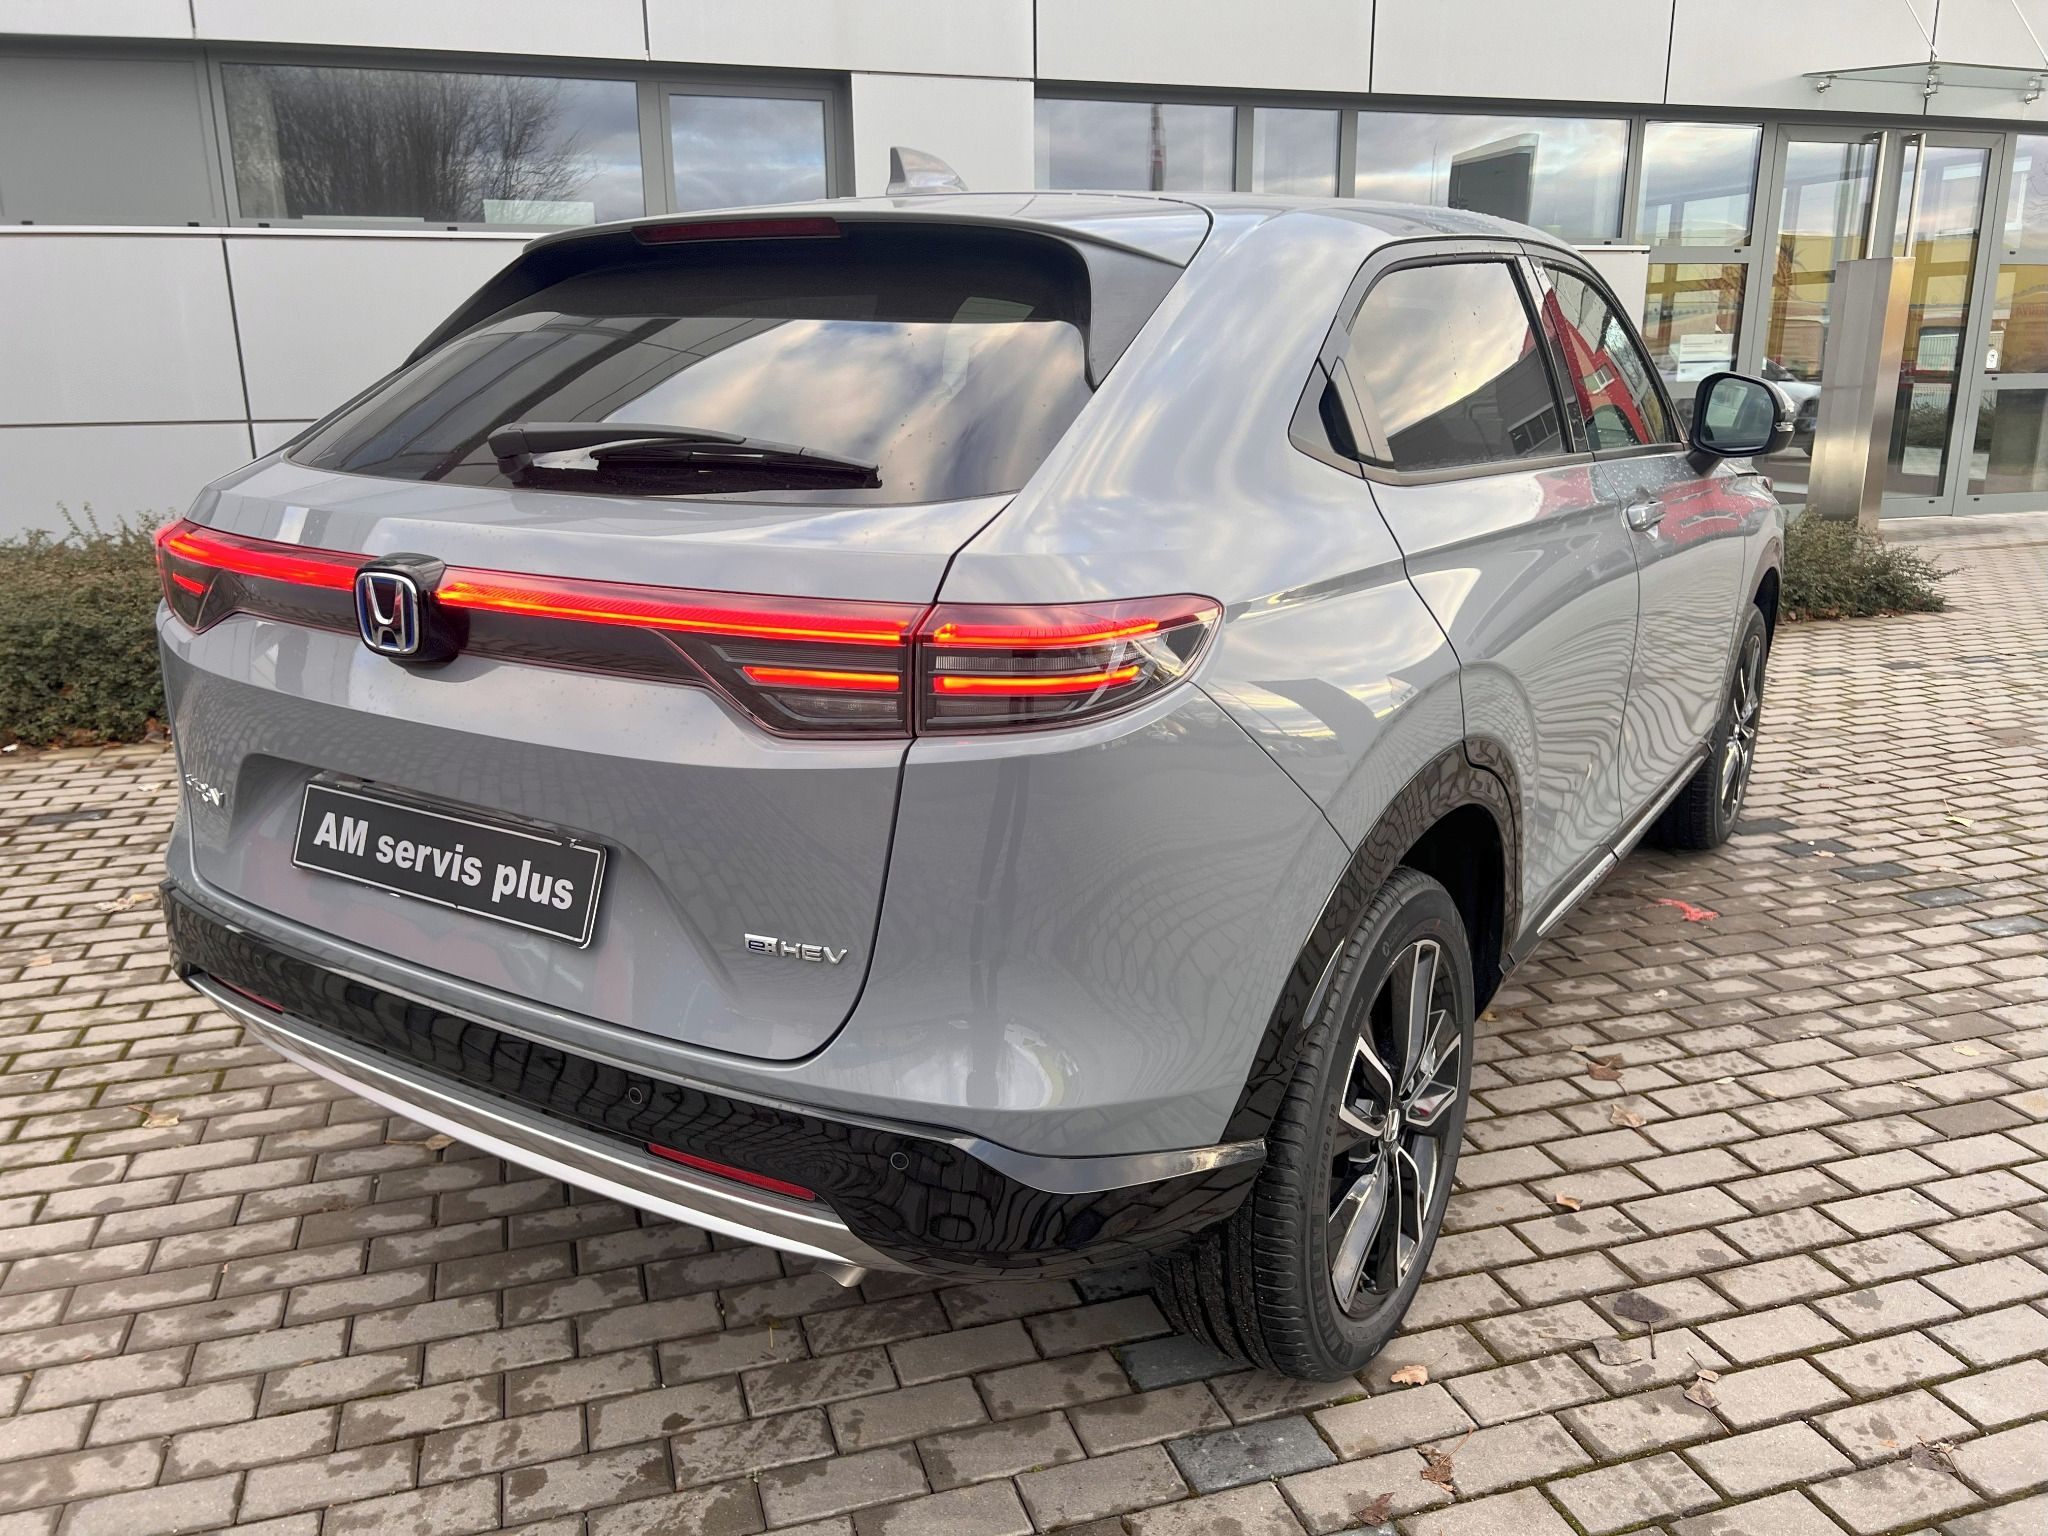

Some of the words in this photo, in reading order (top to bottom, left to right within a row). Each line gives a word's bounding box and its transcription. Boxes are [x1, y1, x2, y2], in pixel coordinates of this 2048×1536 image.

[313, 812, 369, 857] AM
[375, 835, 482, 886] servis
[491, 860, 574, 910] plus
